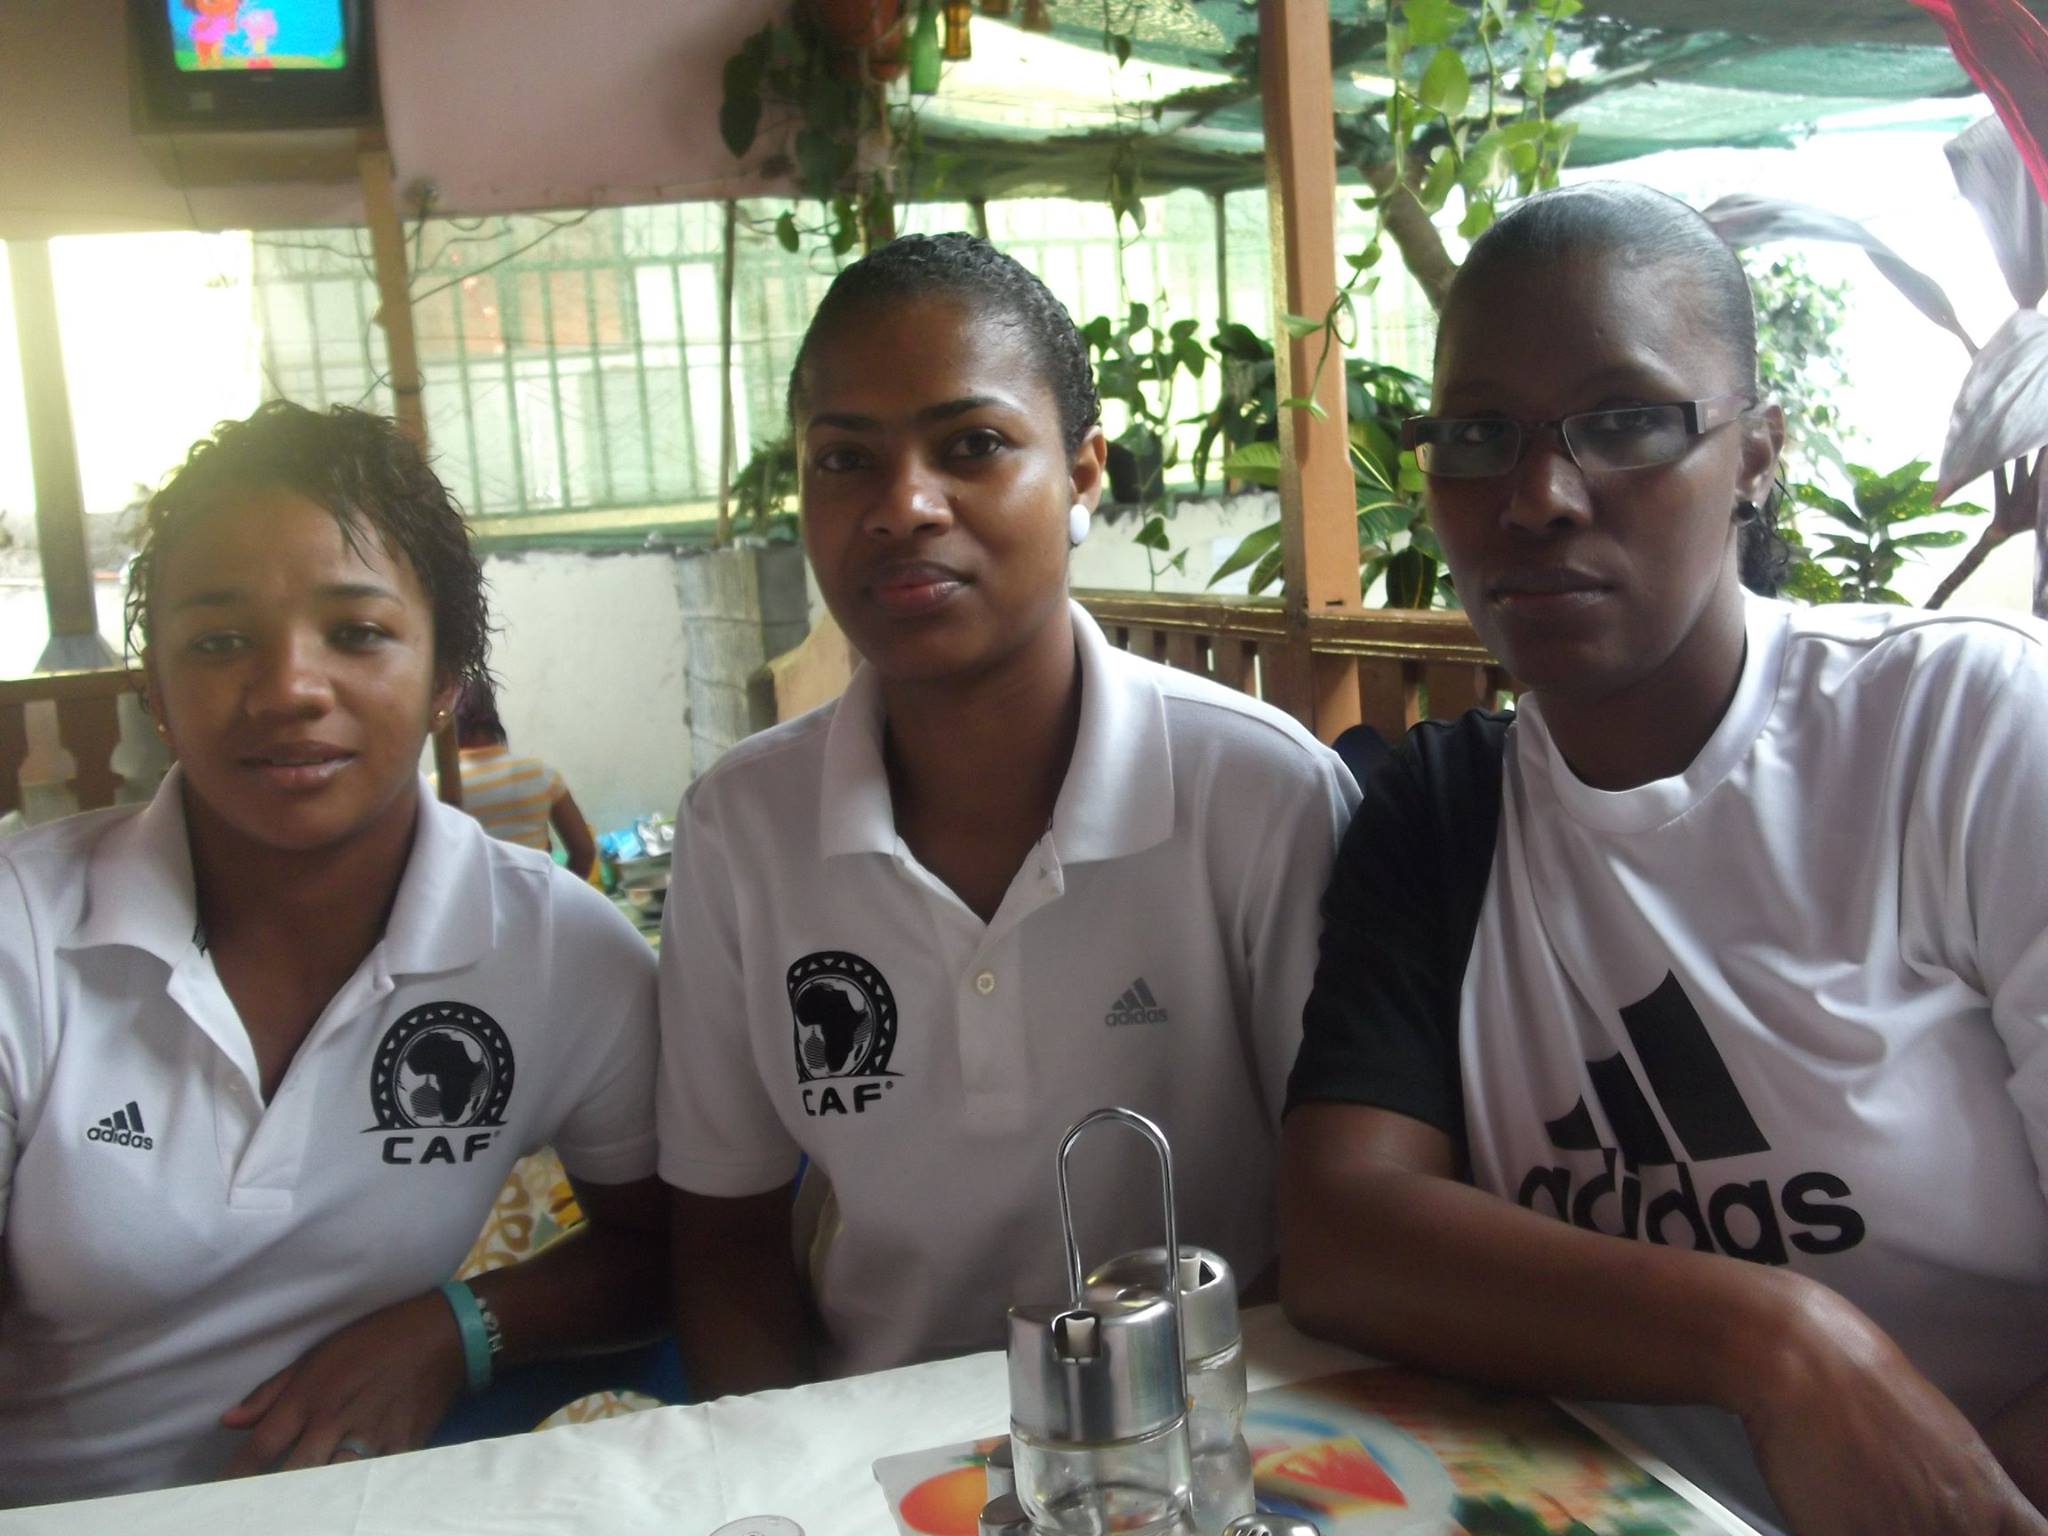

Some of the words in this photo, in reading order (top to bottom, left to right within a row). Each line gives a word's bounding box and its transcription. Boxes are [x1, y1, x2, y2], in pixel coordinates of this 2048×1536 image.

[1104, 1007, 1169, 1027] adidas
[802, 1083, 883, 1117] CAF
[86, 1126, 153, 1151] adidas
[382, 1132, 492, 1165] CAF
[1518, 1146, 1866, 1266] adidas
